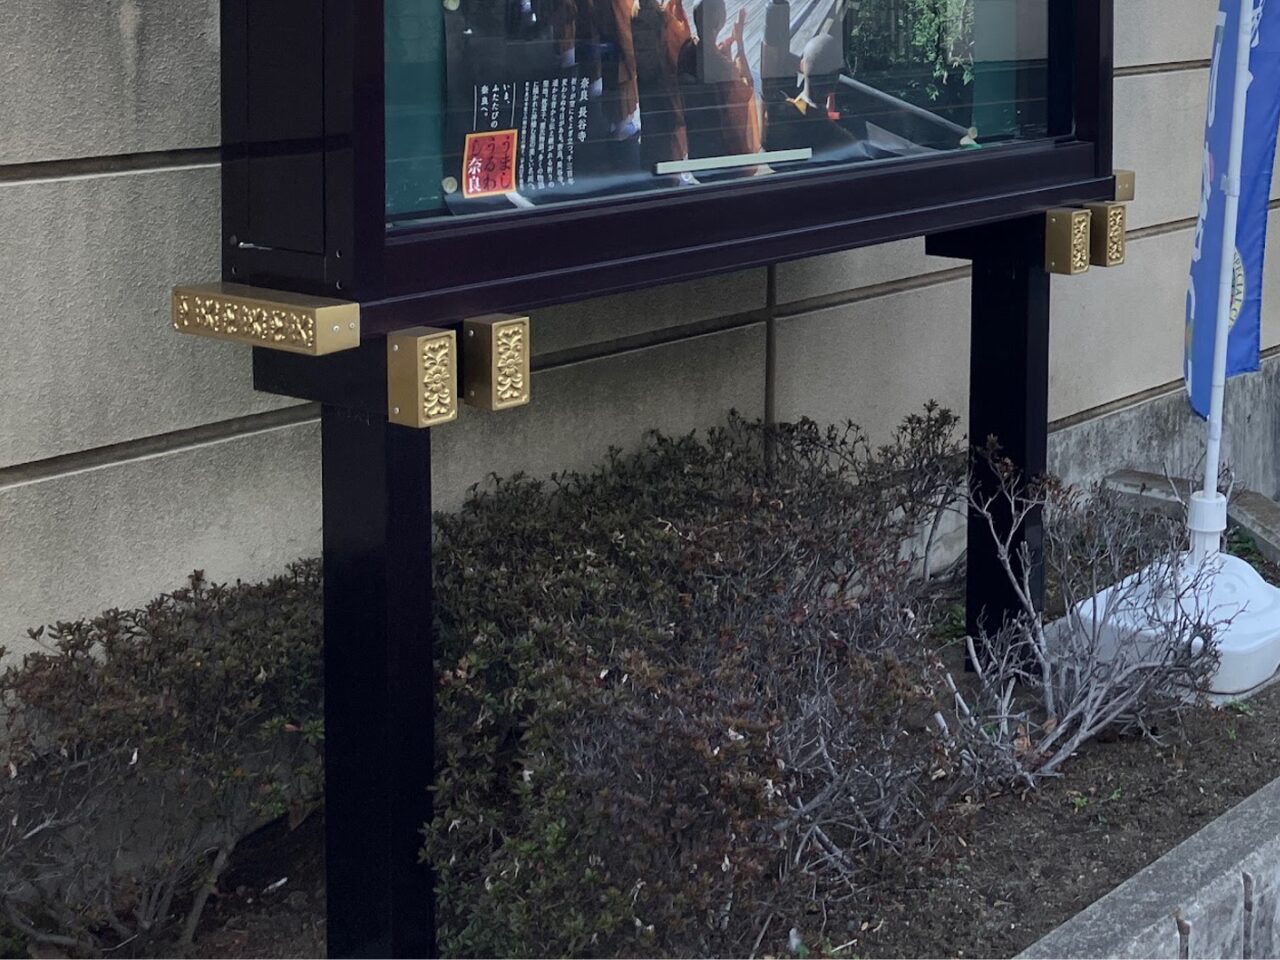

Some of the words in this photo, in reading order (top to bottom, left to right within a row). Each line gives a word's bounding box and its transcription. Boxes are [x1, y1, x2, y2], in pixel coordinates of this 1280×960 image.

[490, 83, 500, 128] ふたたびの
[579, 77, 590, 102] 奈良
[578, 105, 588, 142] 長谷寺
[499, 135, 511, 189] うまし
